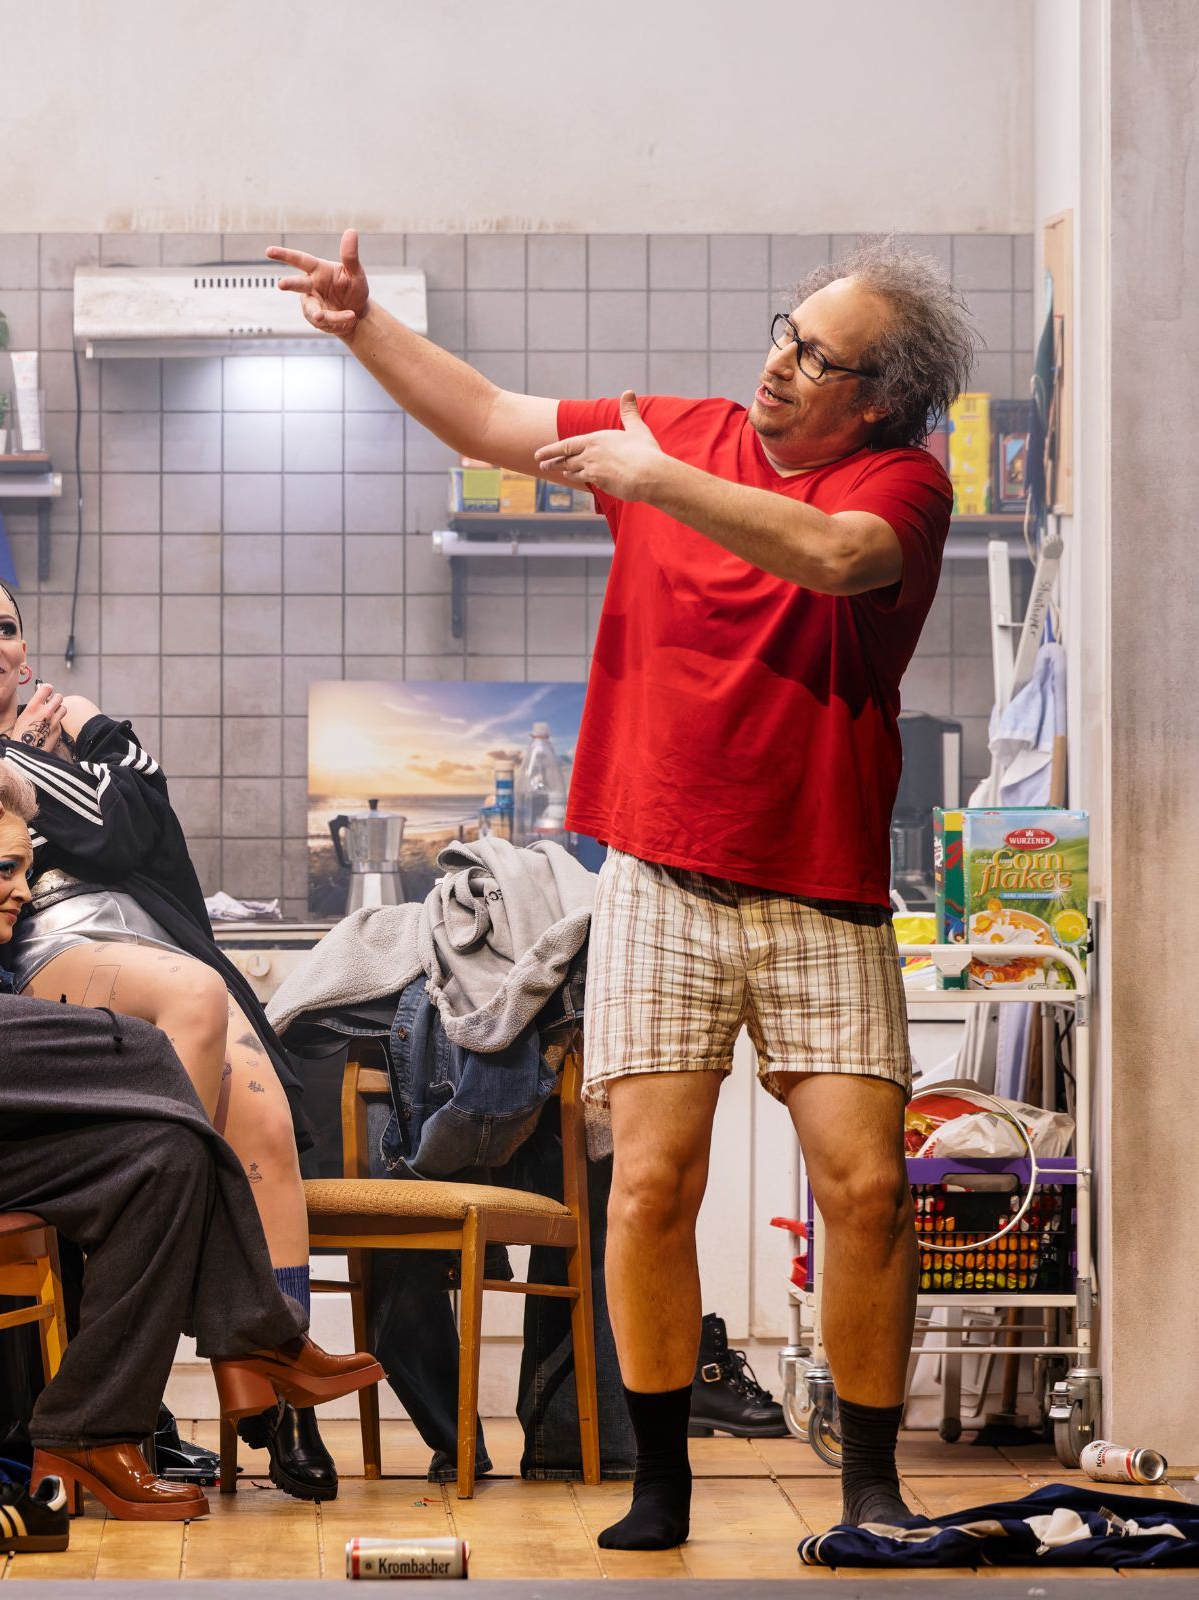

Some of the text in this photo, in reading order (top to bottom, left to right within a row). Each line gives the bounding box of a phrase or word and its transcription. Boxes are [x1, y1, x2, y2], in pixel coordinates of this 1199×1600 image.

[1009, 837, 1051, 845] WURZENER
[992, 848, 1064, 870] Corn
[974, 864, 1073, 897] flakes
[378, 1558, 451, 1575] Krombacher
